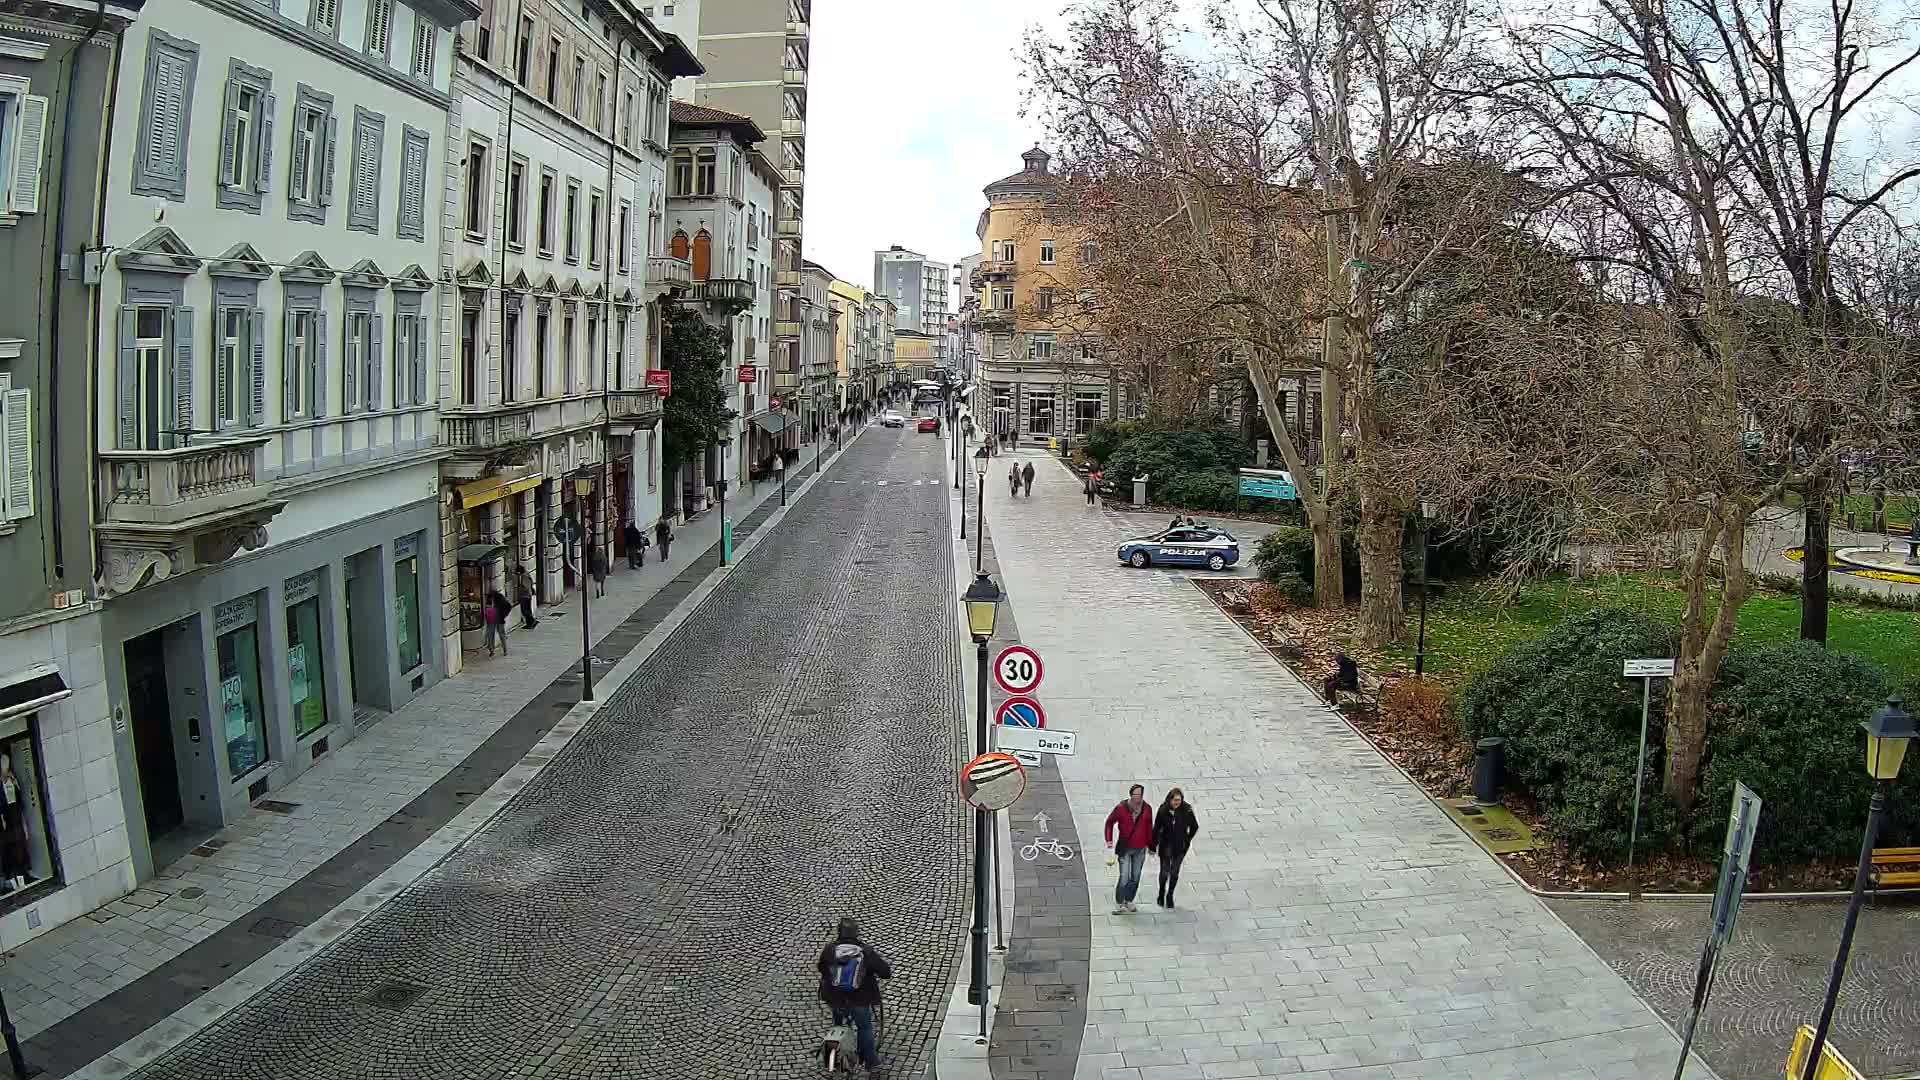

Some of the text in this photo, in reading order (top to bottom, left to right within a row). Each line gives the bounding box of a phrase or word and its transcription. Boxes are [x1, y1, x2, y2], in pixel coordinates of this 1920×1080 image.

[1159, 548, 1206, 556] POLIZIA
[1005, 659, 1033, 681] 30
[1038, 739, 1070, 750] Dante
